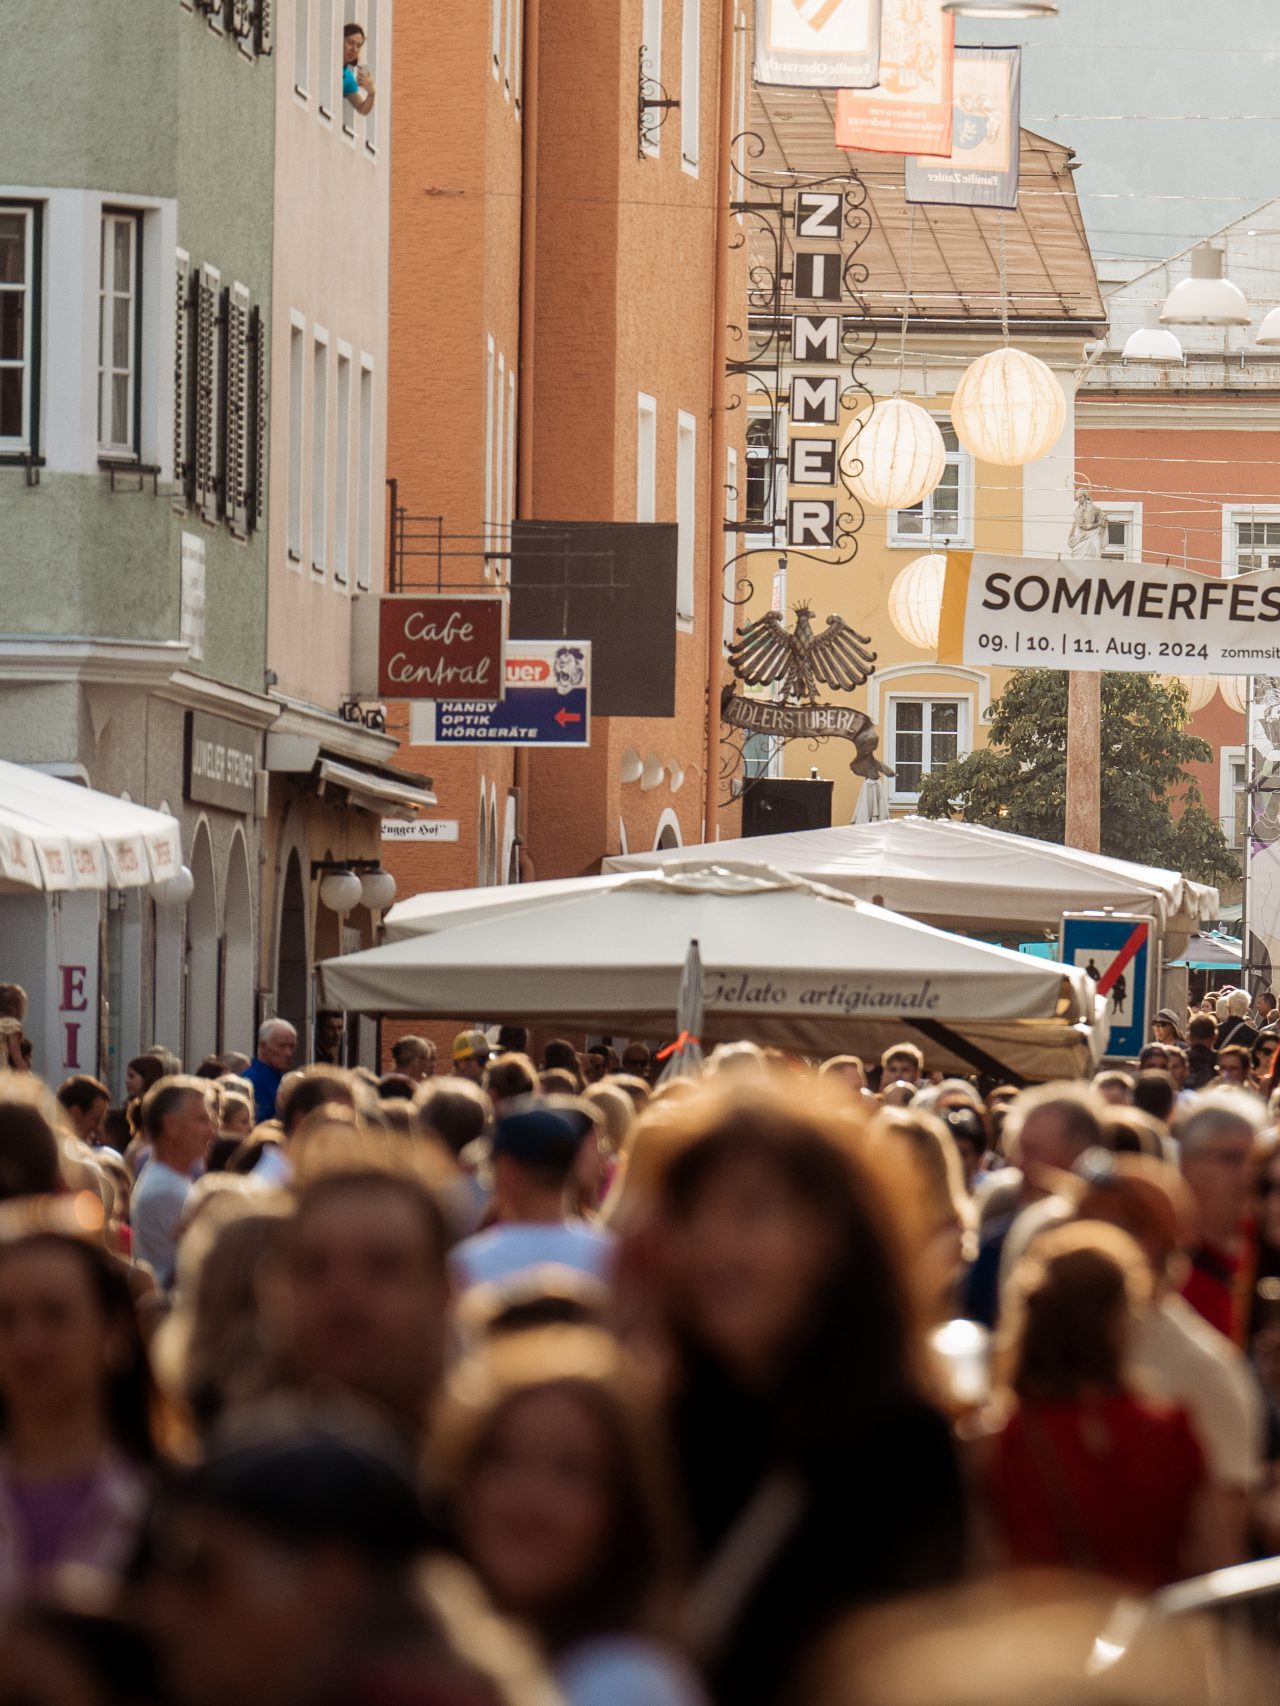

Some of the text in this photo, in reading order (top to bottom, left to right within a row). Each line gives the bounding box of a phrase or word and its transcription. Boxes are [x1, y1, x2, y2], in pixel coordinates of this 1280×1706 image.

[792, 193, 839, 544] ZIMMER
[404, 612, 474, 644] Cafe
[978, 633, 1008, 651] 09.
[1026, 636, 1055, 651] 10.
[1073, 638, 1099, 653] 11.
[1105, 637, 1151, 659] Aug.
[1158, 642, 1209, 660] 2024
[388, 653, 490, 686] Central
[505, 664, 543, 681] uer
[442, 703, 497, 712] HANDY
[442, 715, 491, 725] OPTIK
[441, 726, 538, 738] HÖRGERÄTE
[799, 978, 940, 1014] artigianale
